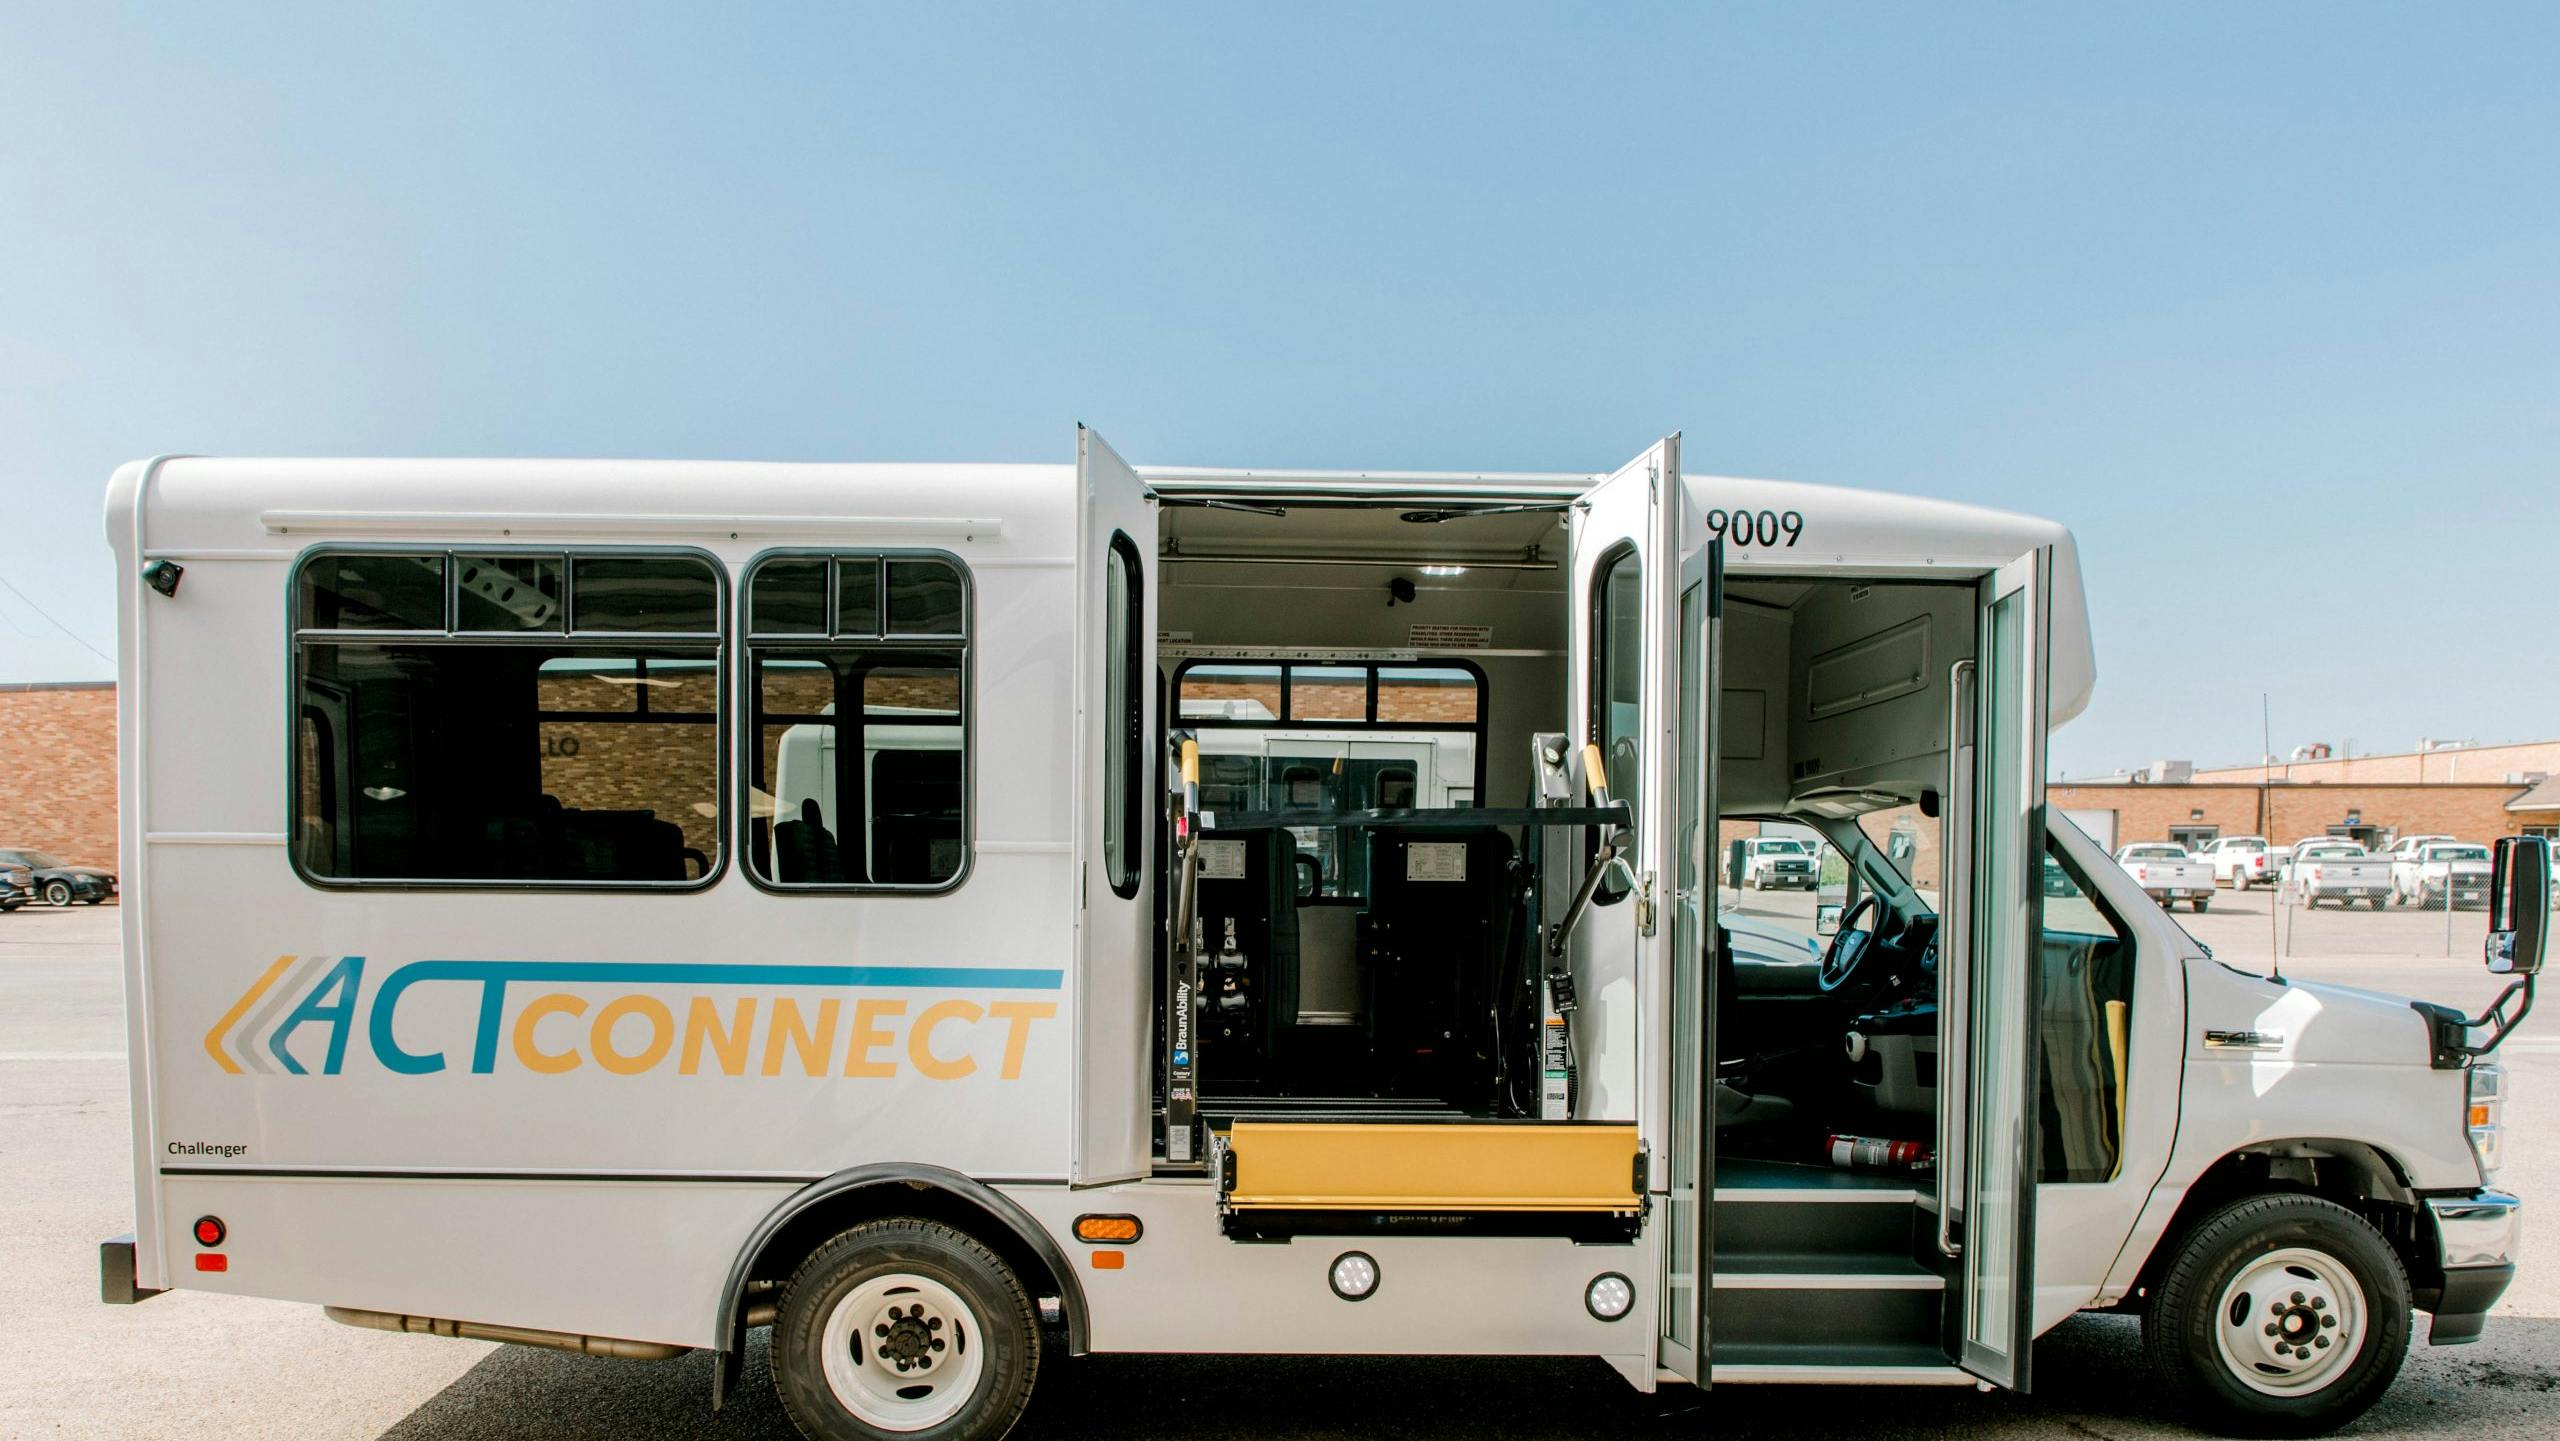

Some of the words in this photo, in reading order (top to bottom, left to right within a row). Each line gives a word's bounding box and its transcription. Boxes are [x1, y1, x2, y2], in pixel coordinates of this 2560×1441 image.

[1706, 509, 1804, 547] 9009
[512, 993, 1058, 1081] CONNECT
[1176, 980, 1191, 1050] BraunAbility
[168, 1141, 247, 1158] Challenger
